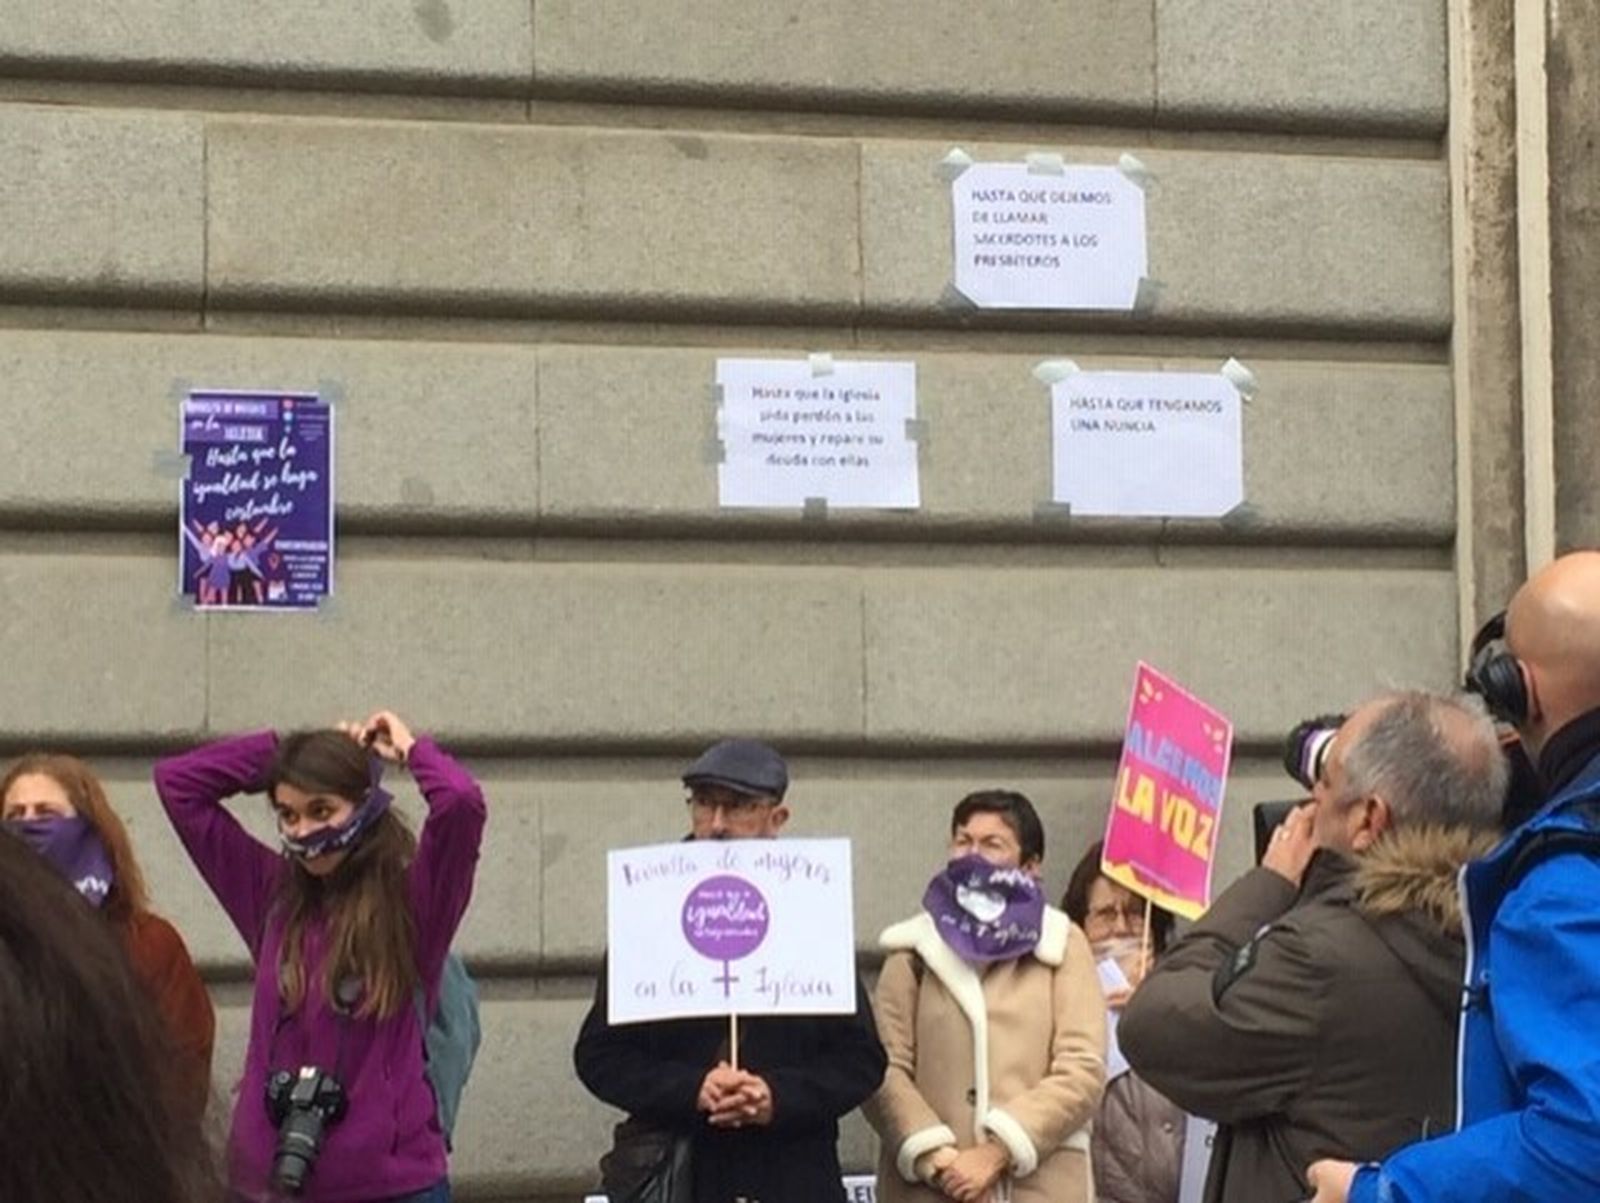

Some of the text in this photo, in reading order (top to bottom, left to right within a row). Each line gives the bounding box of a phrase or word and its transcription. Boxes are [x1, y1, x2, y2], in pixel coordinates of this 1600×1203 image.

[972, 189, 1016, 202] HASTA
[1018, 190, 1047, 204] QUE
[972, 210, 989, 223] DE
[1073, 234, 1099, 248] LOS
[1070, 396, 1113, 411] HASTA
[1116, 397, 1145, 412] QUE
[1117, 766, 1214, 862] LA VOZ
